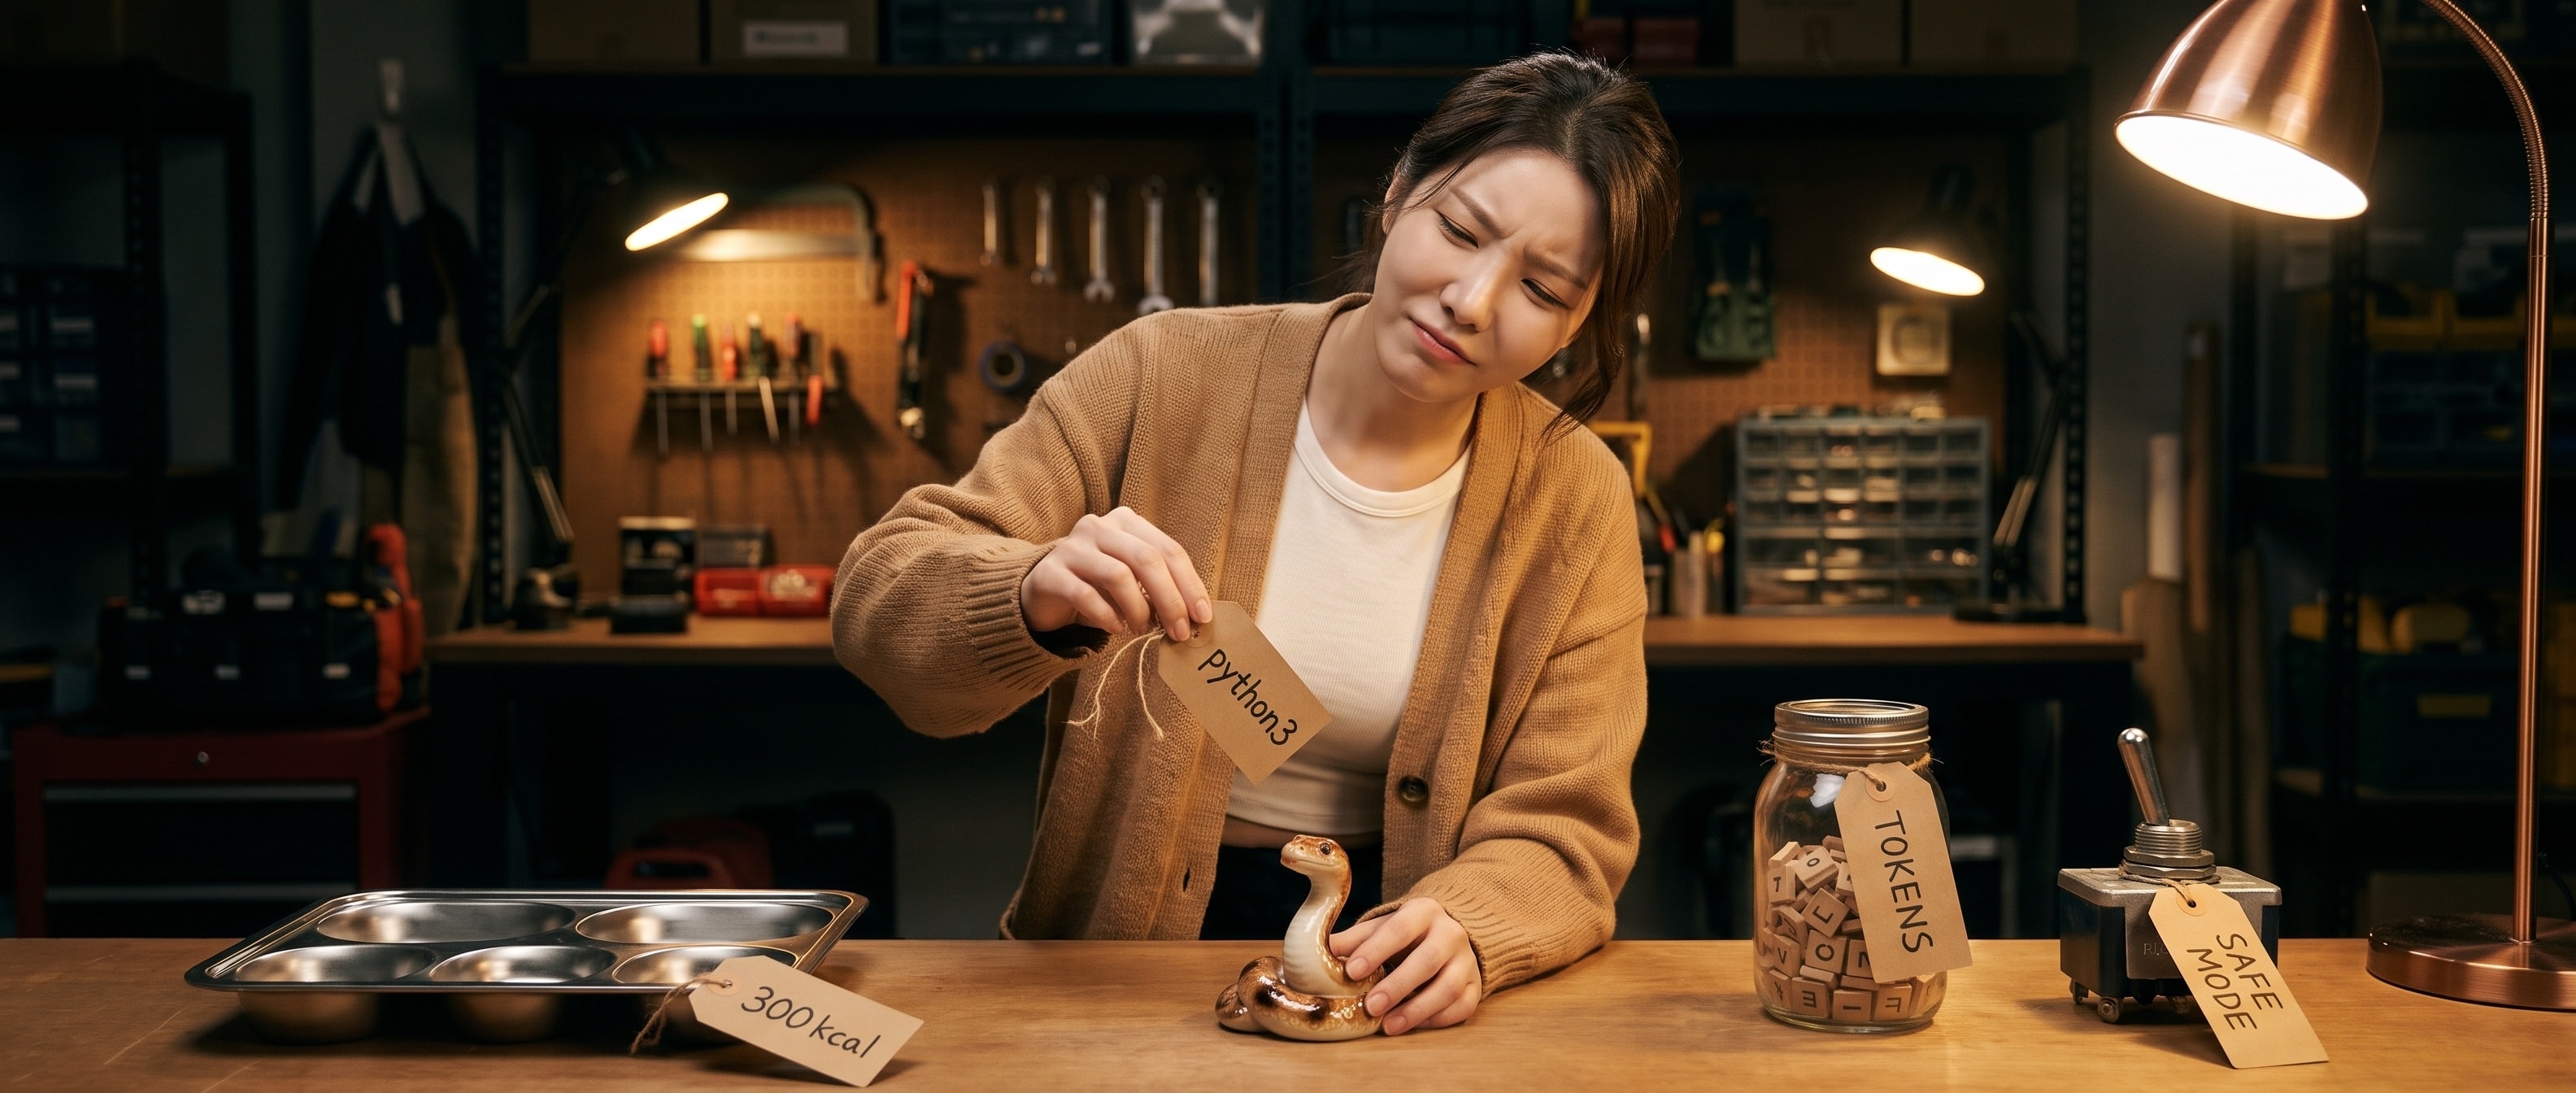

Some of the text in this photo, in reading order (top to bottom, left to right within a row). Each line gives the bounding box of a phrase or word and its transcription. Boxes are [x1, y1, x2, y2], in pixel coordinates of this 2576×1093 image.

[1197, 648, 1299, 746] python3
[1773, 876, 1782, 893] T
[1874, 809, 1934, 953] TOKENS
[2186, 948, 2258, 1030] MODE
[2216, 933, 2284, 1011] SAFE
[741, 986, 881, 1058] 300 kcal
